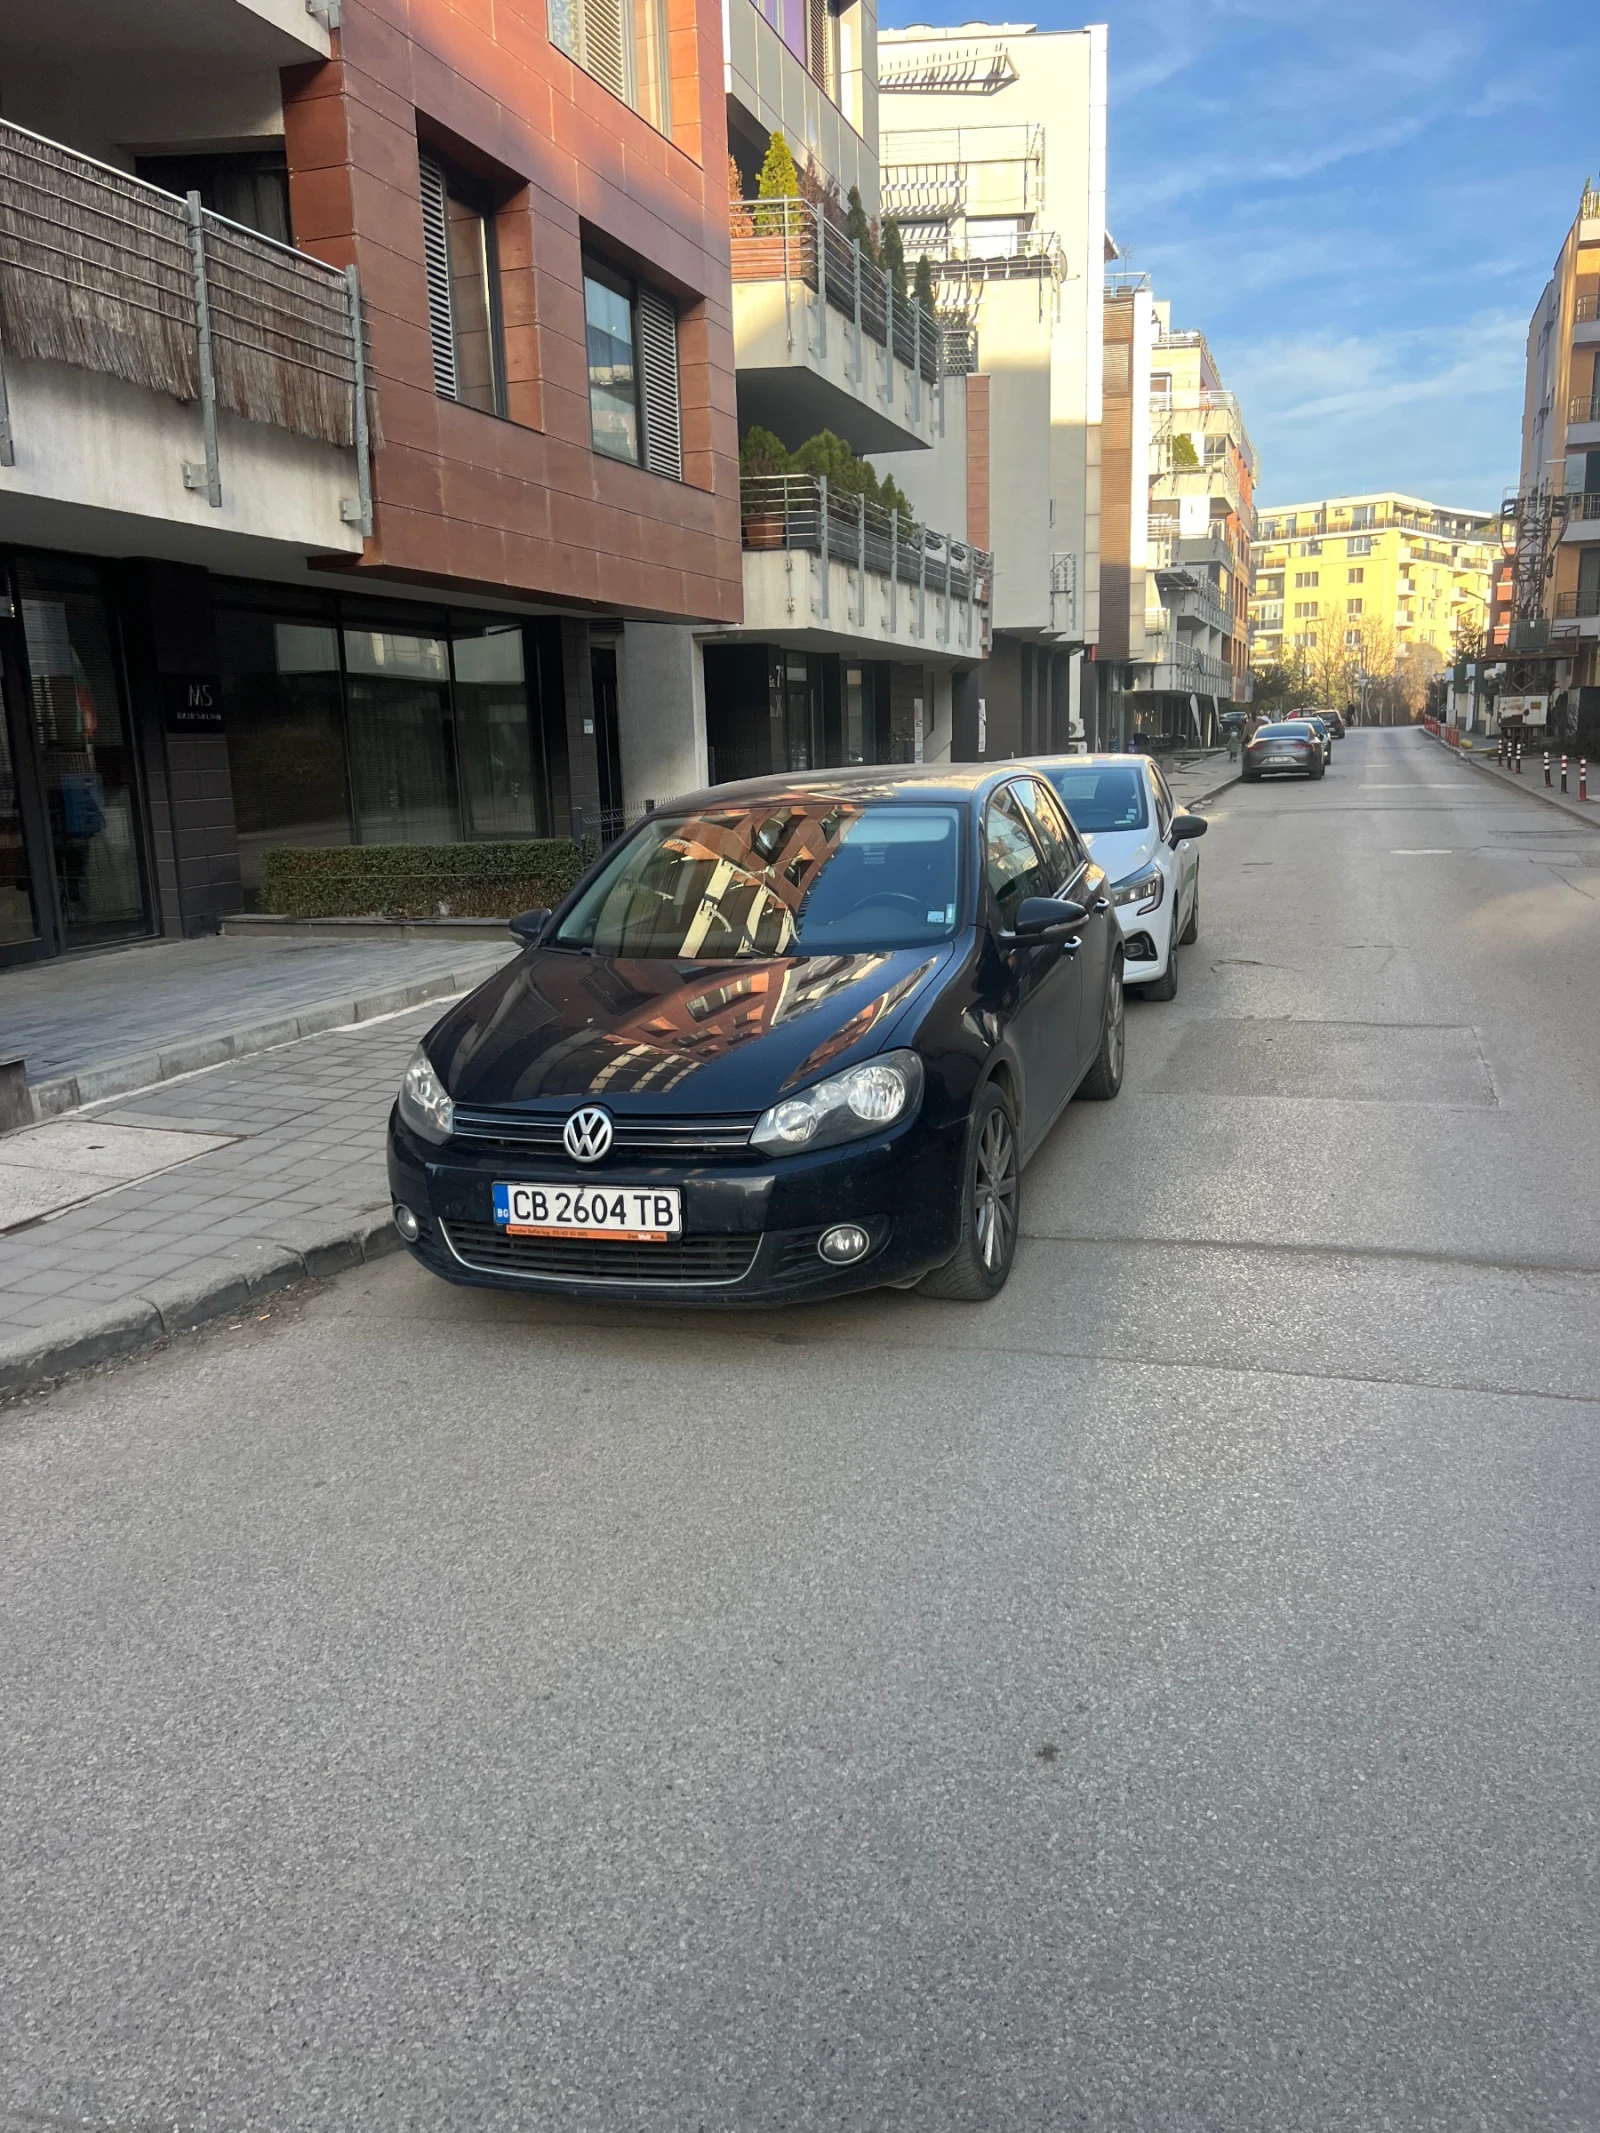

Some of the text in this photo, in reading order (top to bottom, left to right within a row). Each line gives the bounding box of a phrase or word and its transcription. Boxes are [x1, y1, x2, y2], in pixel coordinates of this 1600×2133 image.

[776, 665, 781, 688] 7
[188, 684, 213, 707] MS
[497, 1208, 509, 1218] BG
